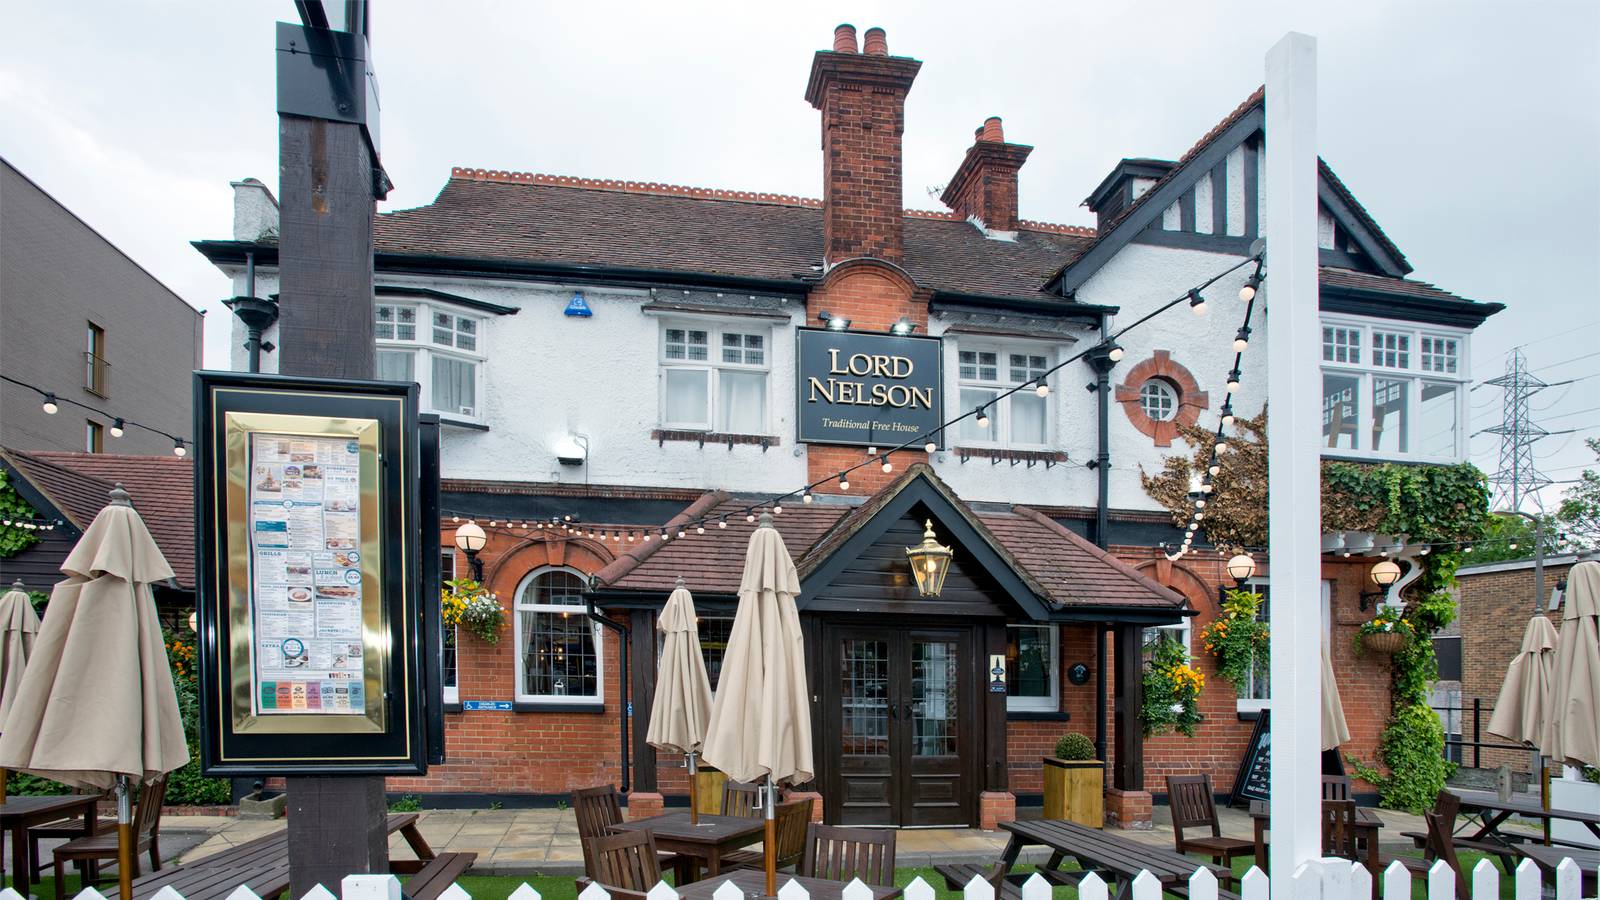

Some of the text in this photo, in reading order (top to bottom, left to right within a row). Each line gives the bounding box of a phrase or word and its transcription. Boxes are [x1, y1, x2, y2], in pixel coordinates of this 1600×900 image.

[828, 348, 914, 378] LORD
[808, 377, 933, 409] NELSON
[822, 418, 919, 433] Traditional Free House
